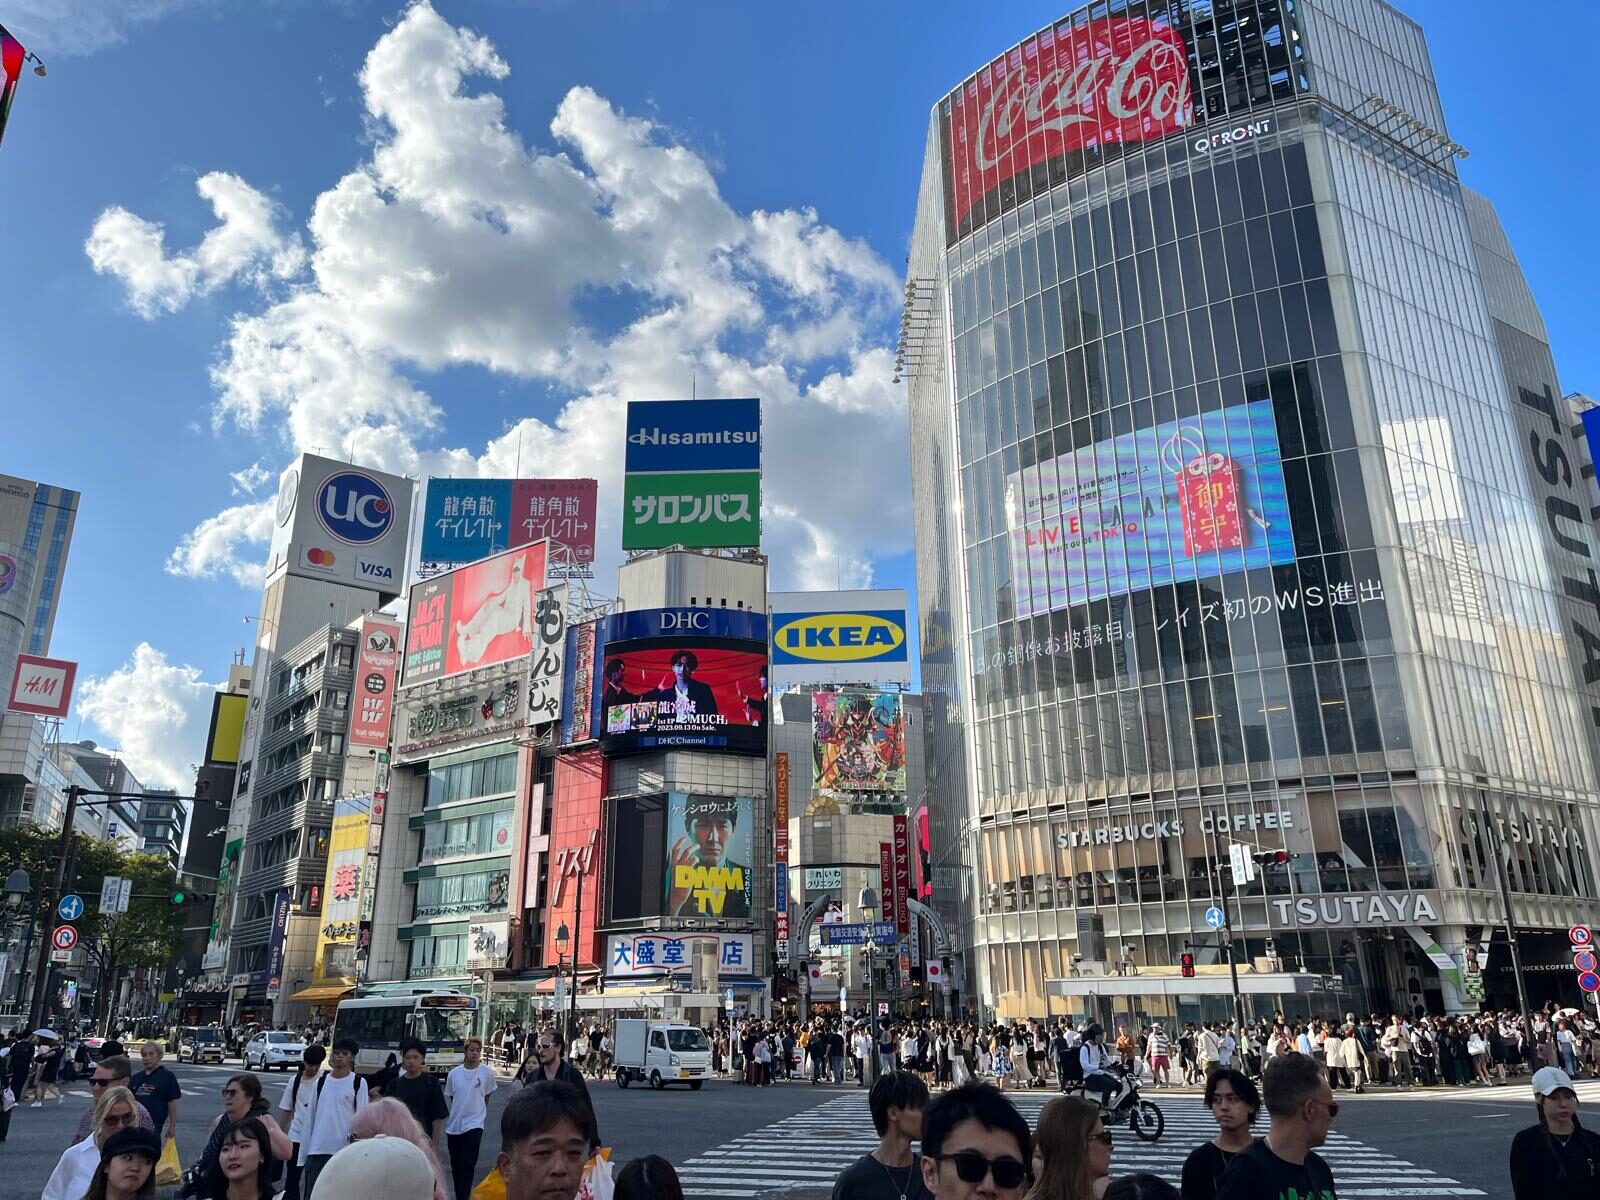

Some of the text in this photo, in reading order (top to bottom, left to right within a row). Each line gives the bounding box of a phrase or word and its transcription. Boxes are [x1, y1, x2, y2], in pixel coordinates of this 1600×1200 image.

[1195, 120, 1270, 154] QFRONT
[629, 428, 757, 445] Hisamitsu
[326, 485, 388, 528] UC
[443, 496, 495, 517] 龍角散
[530, 496, 580, 517] 龍角散
[632, 493, 751, 524] サロンパス
[435, 518, 502, 538] ダイレクト
[522, 518, 589, 539] ダイレクト
[360, 561, 392, 579] VISA
[660, 612, 709, 629] DHC
[786, 625, 895, 648] IKEA
[528, 590, 563, 717] もんじゃ
[24, 675, 58, 697] H&M
[672, 801, 752, 817] ケンシロウによろしく
[1057, 811, 1294, 849] STARBUCKS COFFEE
[1496, 818, 1583, 850] TSUTAYA
[894, 822, 907, 880] カラオケ
[675, 865, 744, 890] DMM
[807, 880, 841, 889] クリニック
[815, 870, 841, 878] れいわ
[415, 903, 485, 917] ジャスミンレディースクリニック
[693, 890, 727, 914] TV
[1273, 894, 1438, 926] TSUTAYA
[278, 901, 288, 927] MIZUHO
[830, 925, 894, 938] 全国交通安全実施中
[613, 940, 744, 967] 大盛堂店
[1545, 963, 1574, 971] COFFEE
